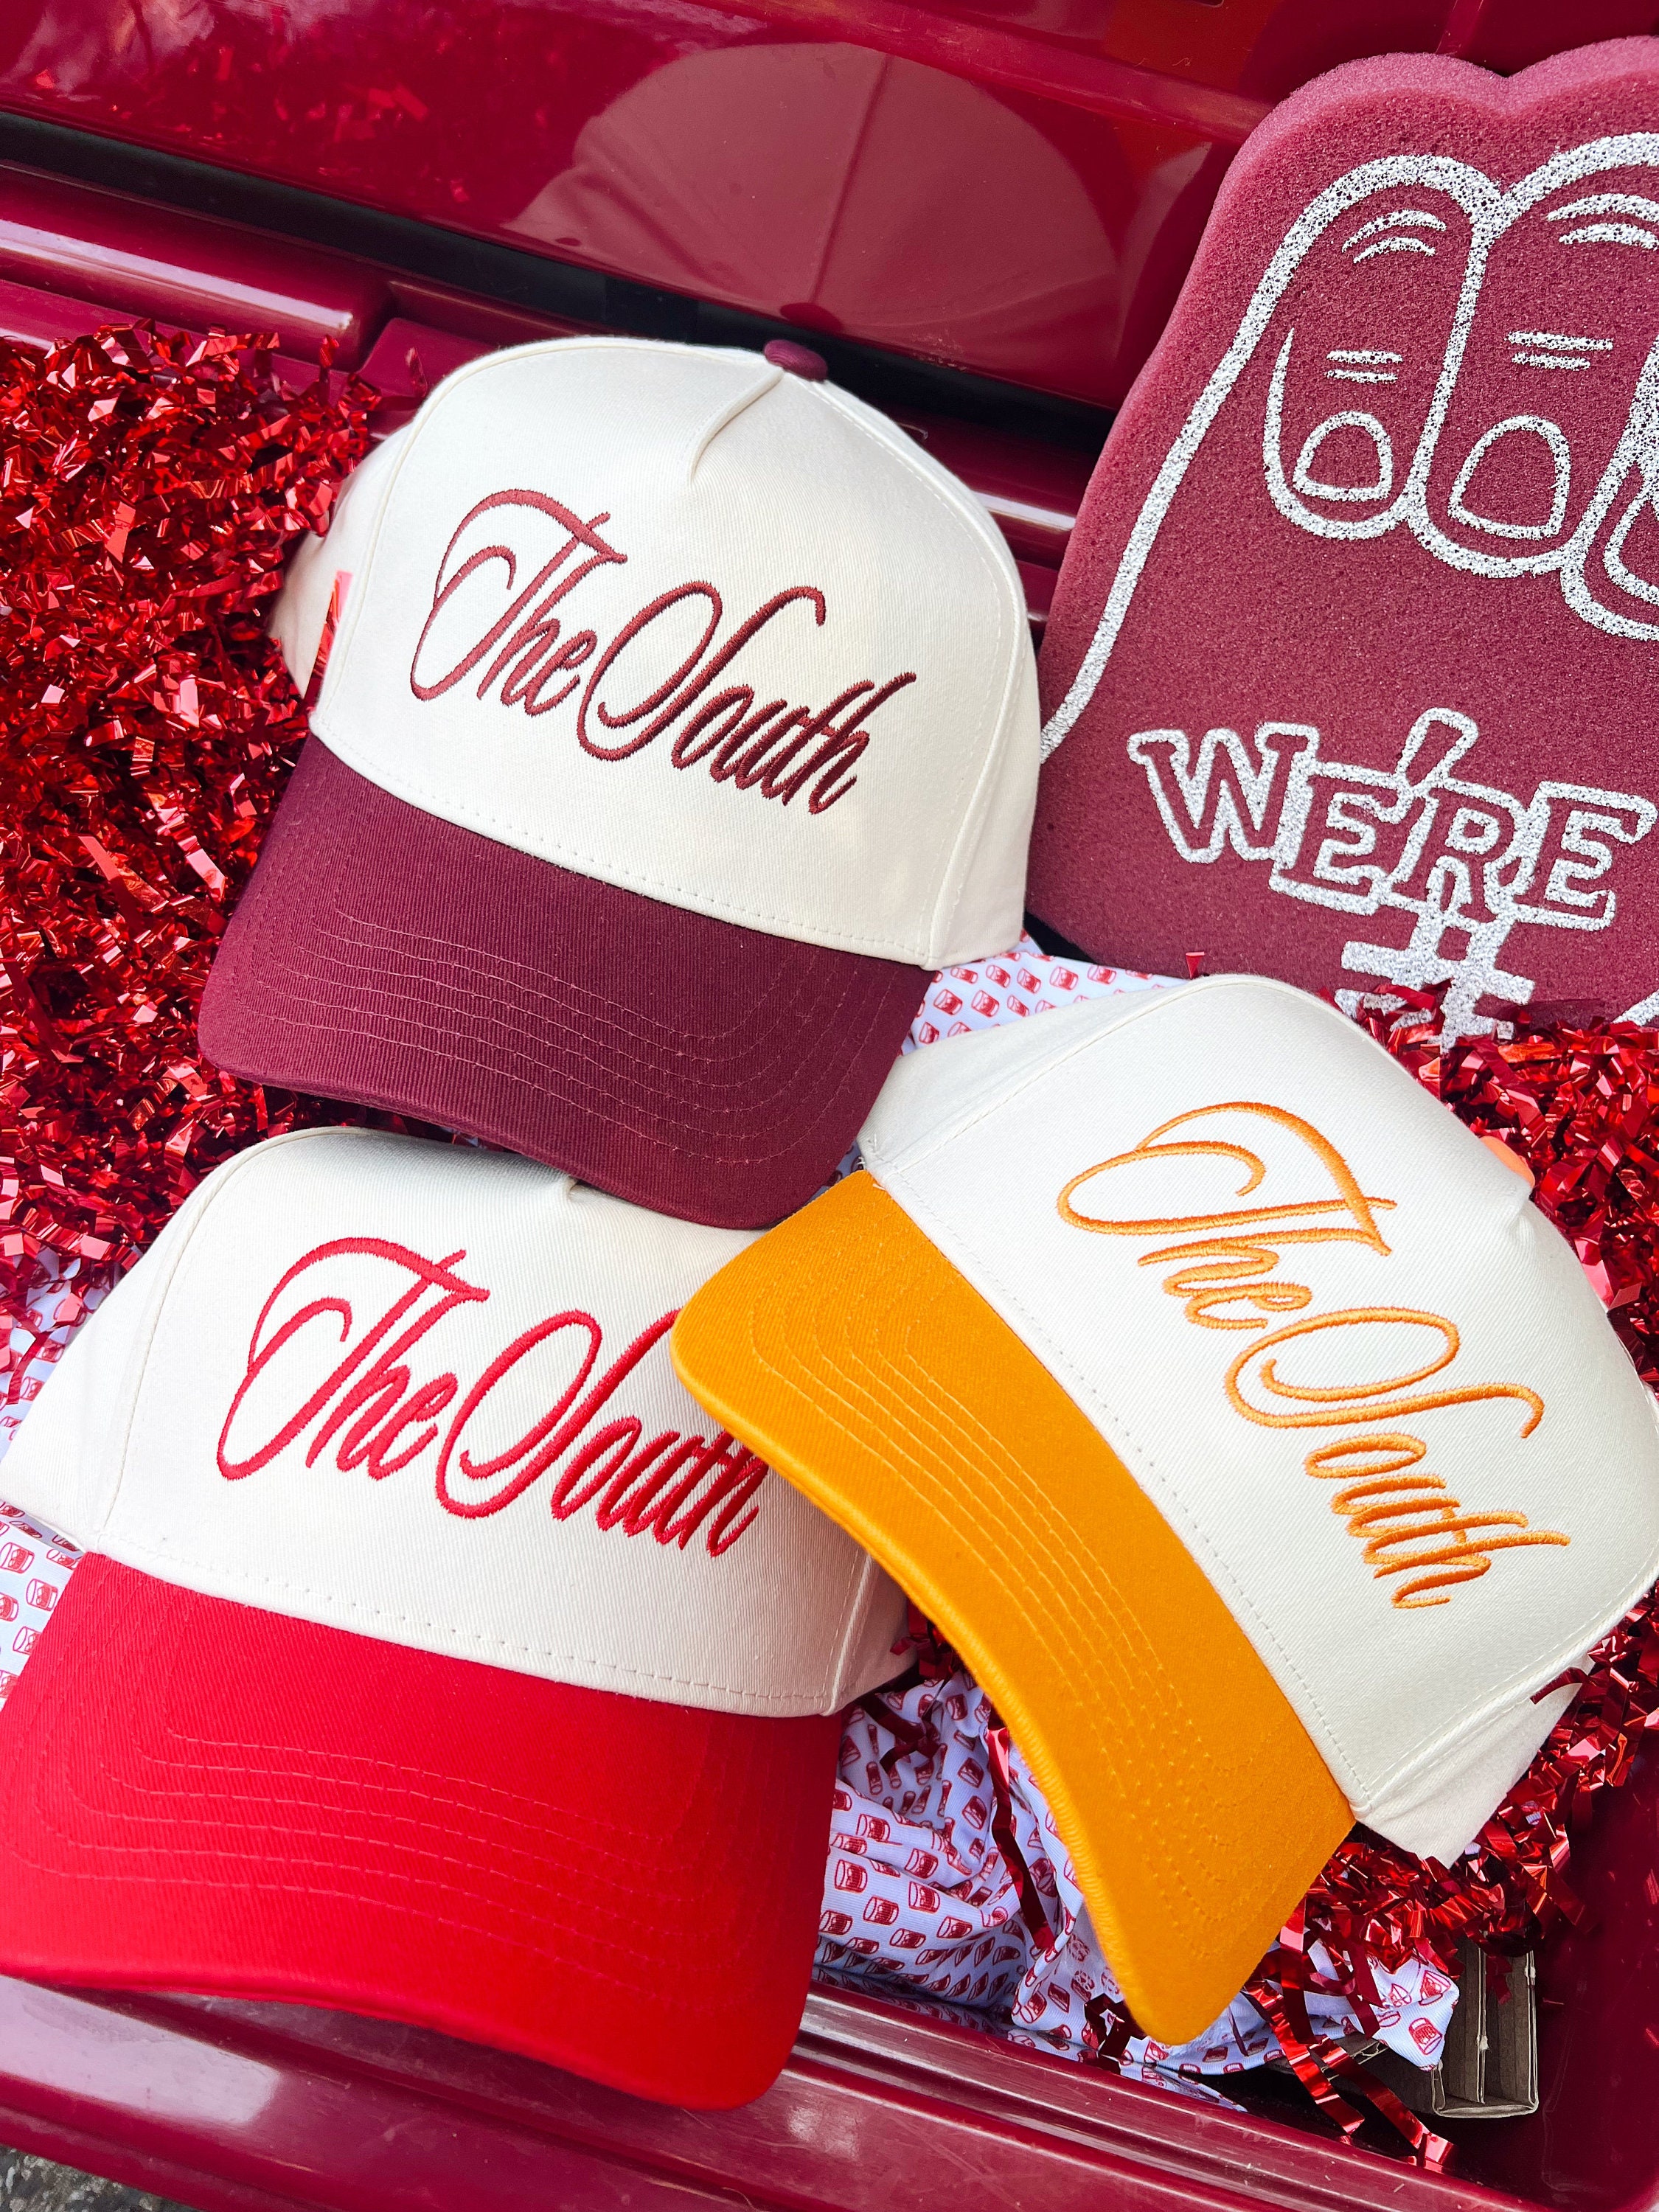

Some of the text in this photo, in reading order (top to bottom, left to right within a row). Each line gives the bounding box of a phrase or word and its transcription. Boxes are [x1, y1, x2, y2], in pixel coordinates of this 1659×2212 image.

[410, 487, 918, 815] The South
[1127, 706, 1658, 932] WE'RE
[216, 1237, 770, 1559] The South
[1056, 1101, 1571, 1609] The South
